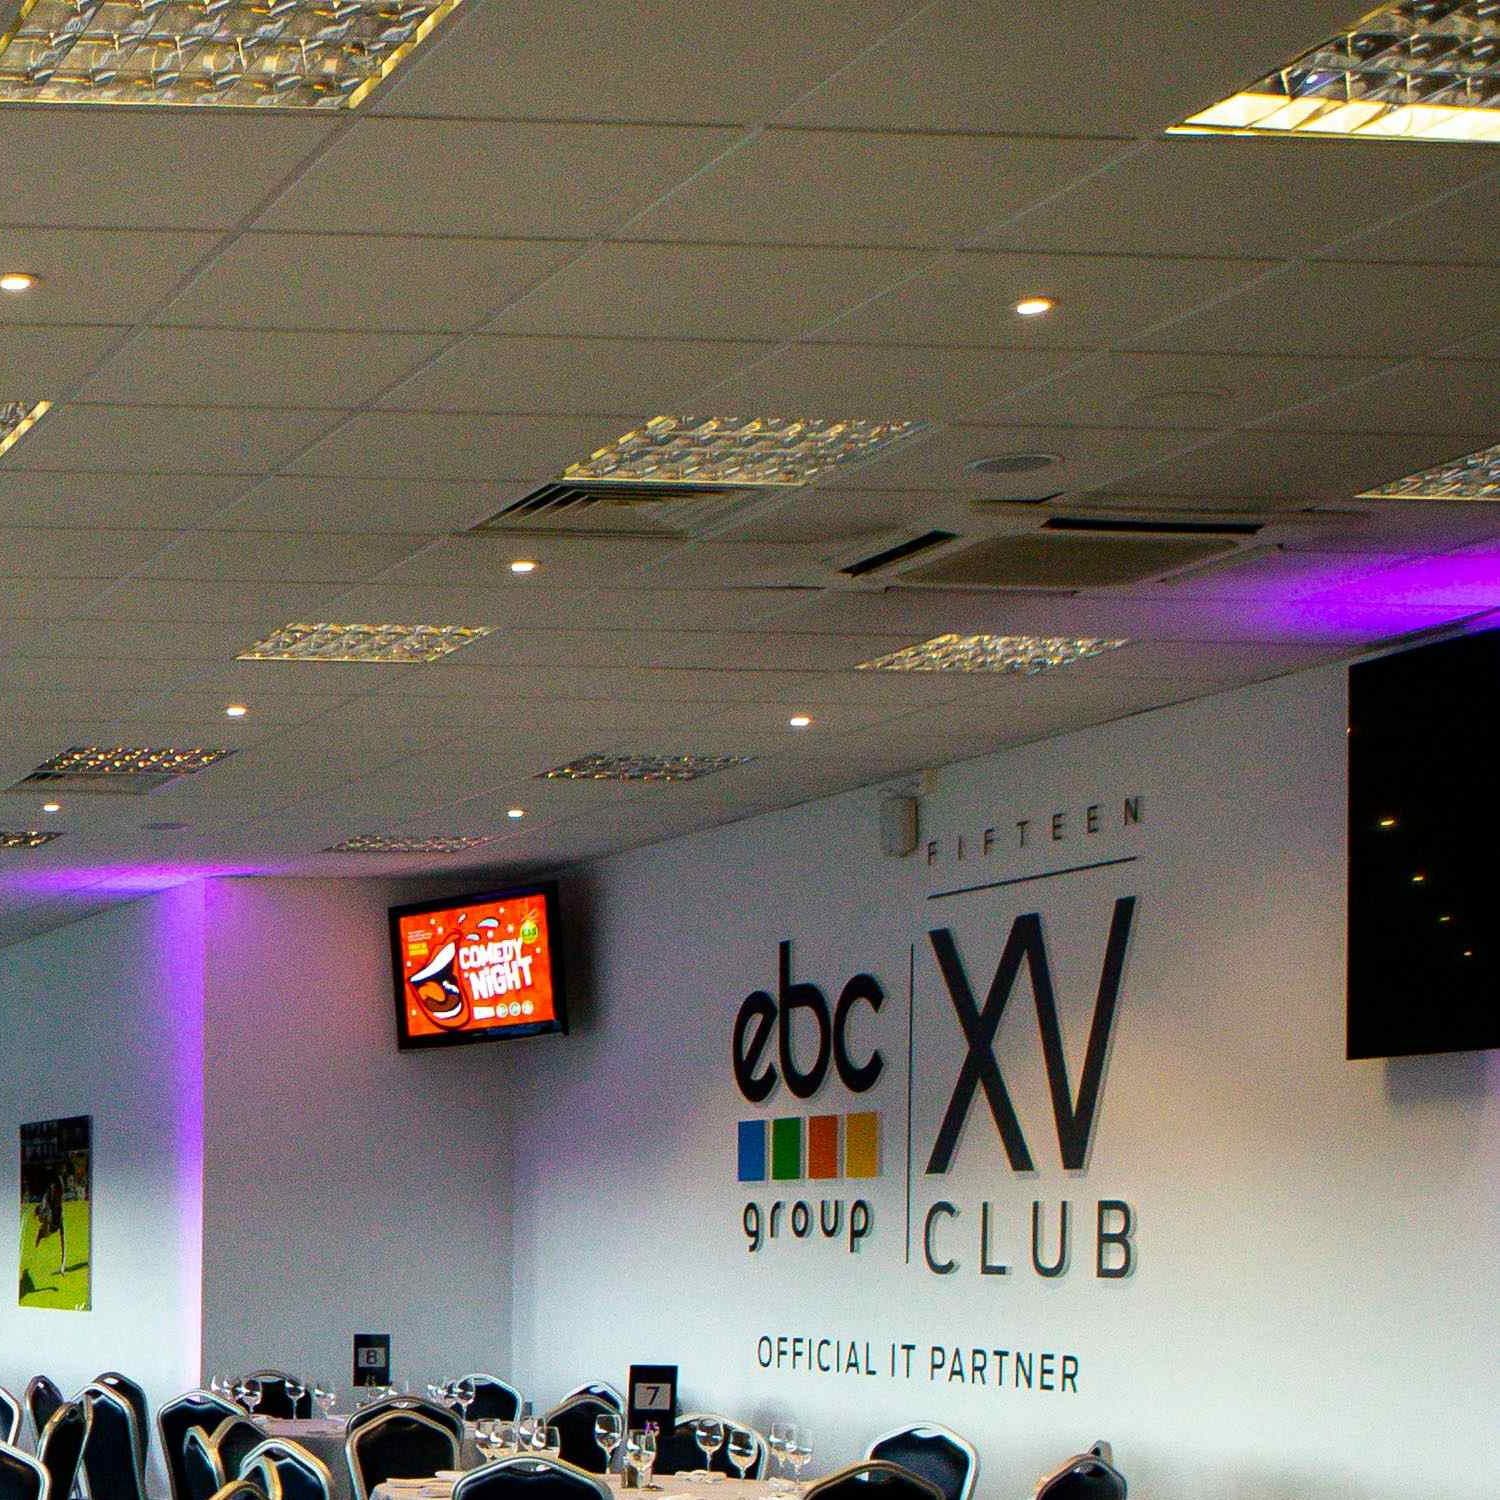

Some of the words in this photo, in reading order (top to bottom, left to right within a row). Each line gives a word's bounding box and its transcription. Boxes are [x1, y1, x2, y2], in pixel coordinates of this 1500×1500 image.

[927, 797, 1141, 866] FIFTEEN
[458, 938, 525, 970] COMEDY
[468, 955, 534, 1001] NIGHT
[731, 939, 885, 1102] ebc
[925, 895, 1138, 1176] XV
[742, 1199, 872, 1254] group
[924, 1199, 1133, 1279] CLUB
[366, 1349, 378, 1365] 8
[757, 1335, 878, 1376] OFFICIAL
[891, 1343, 917, 1379] IT
[930, 1345, 1080, 1394] PARTNER
[645, 1385, 660, 1406] 7
